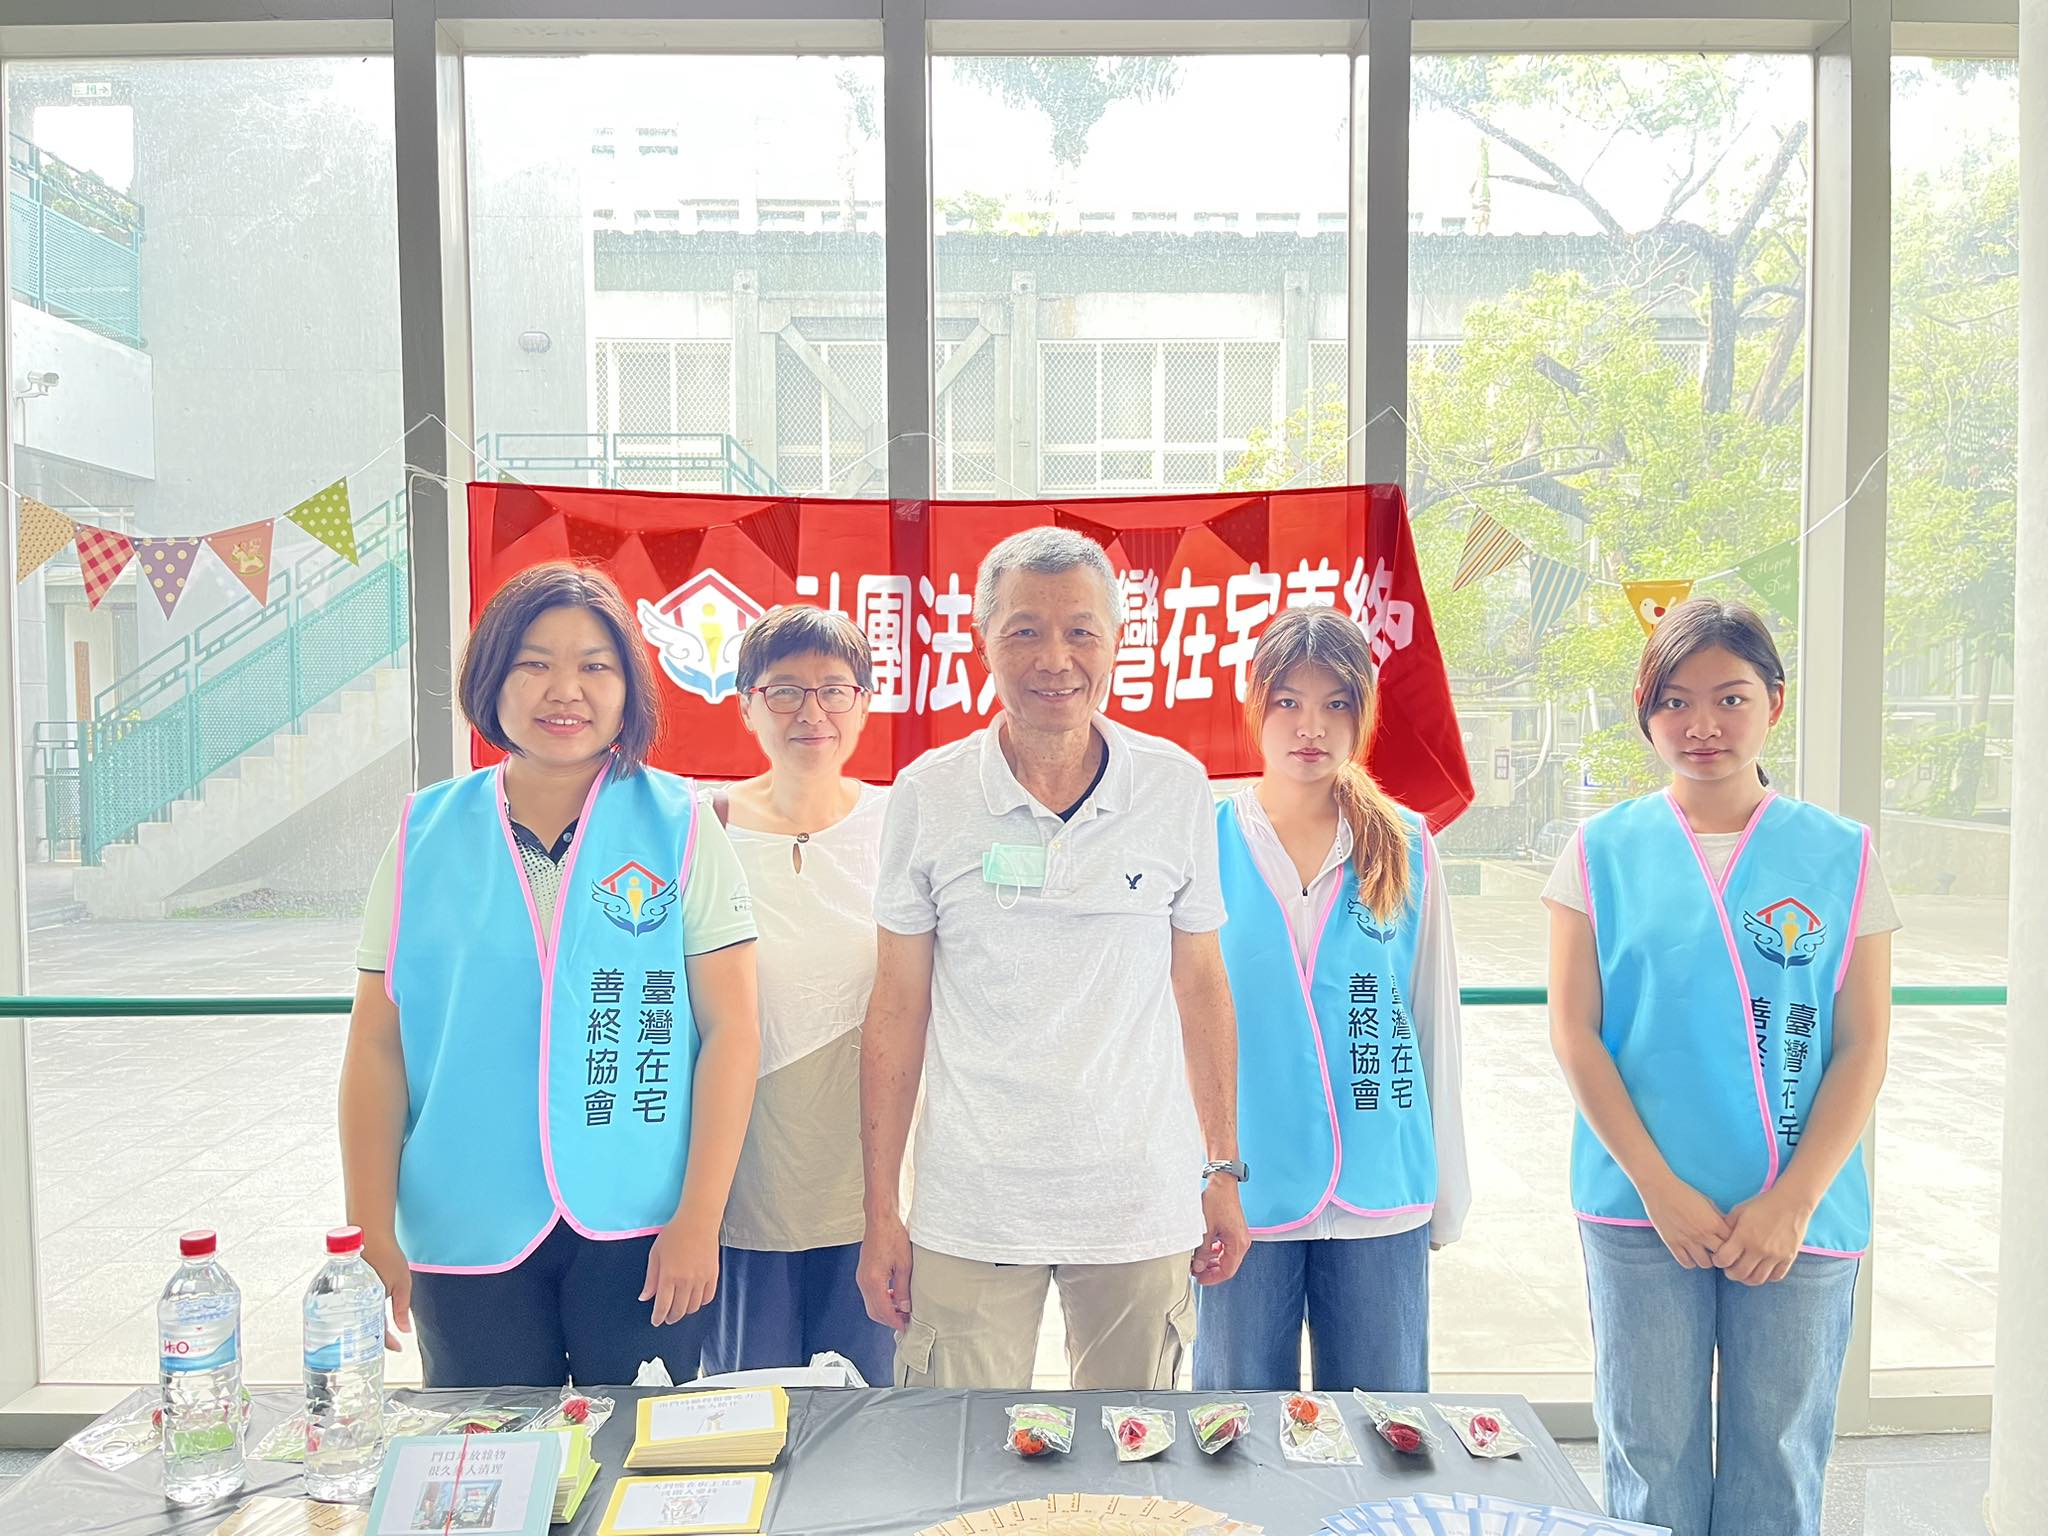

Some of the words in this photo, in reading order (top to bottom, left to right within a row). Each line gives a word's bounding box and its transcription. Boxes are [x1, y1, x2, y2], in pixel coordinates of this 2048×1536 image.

[584, 968, 625, 1126] 善終協會
[632, 970, 676, 1123] 臺灣在宅
[1348, 972, 1381, 1111] 善終協會
